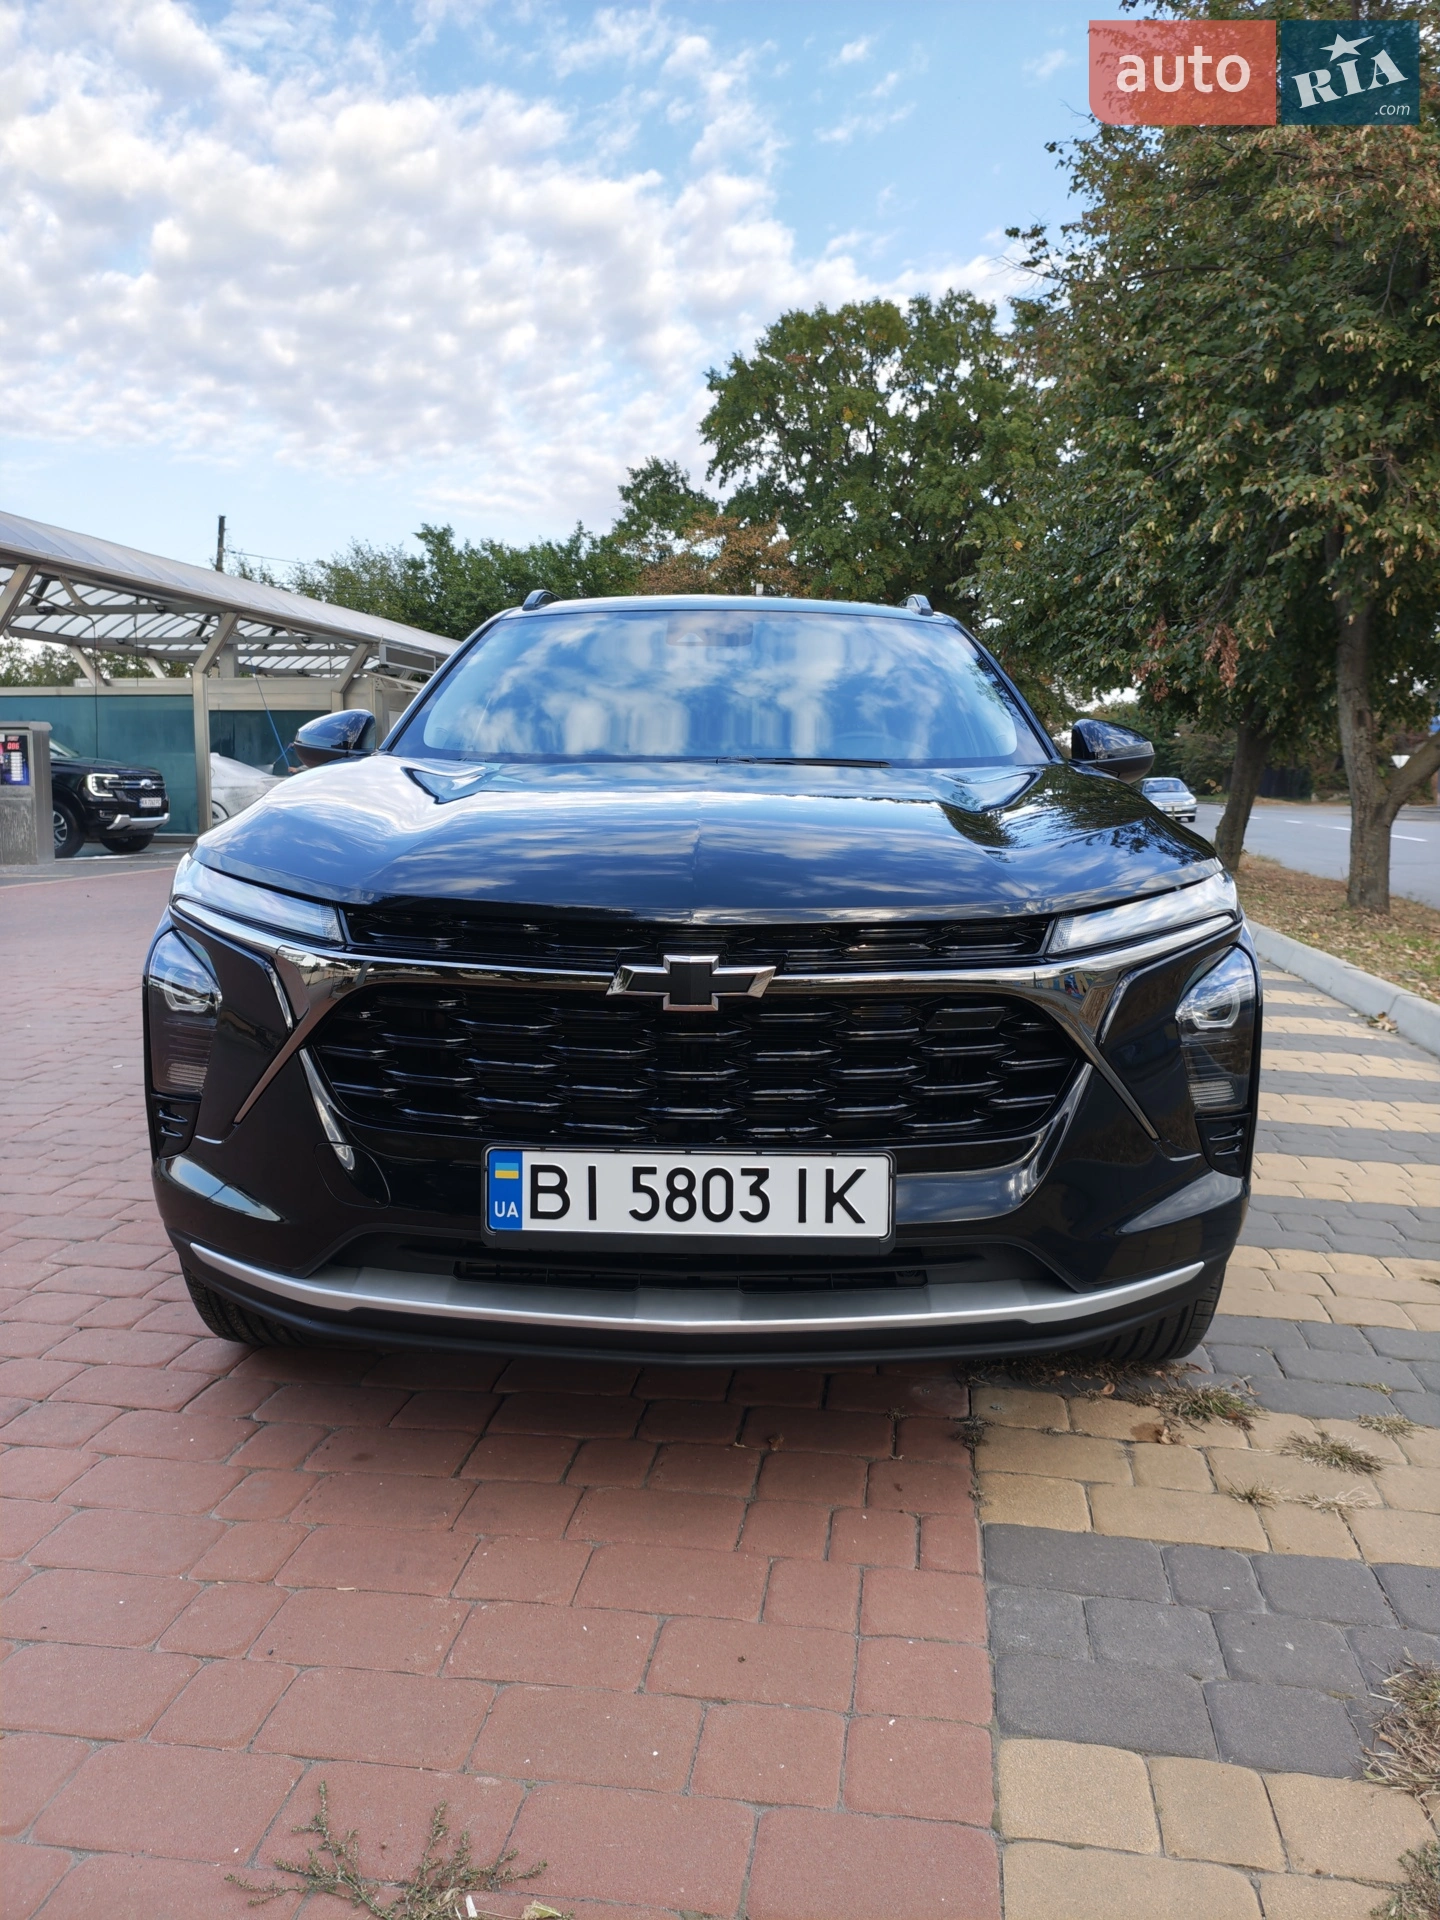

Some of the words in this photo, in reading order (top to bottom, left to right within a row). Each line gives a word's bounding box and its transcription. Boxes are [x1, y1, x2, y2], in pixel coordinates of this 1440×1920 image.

[494, 1201, 519, 1219] UA
[529, 1164, 597, 1221] BI
[628, 1166, 771, 1222] 5803
[797, 1168, 867, 1224] IK
